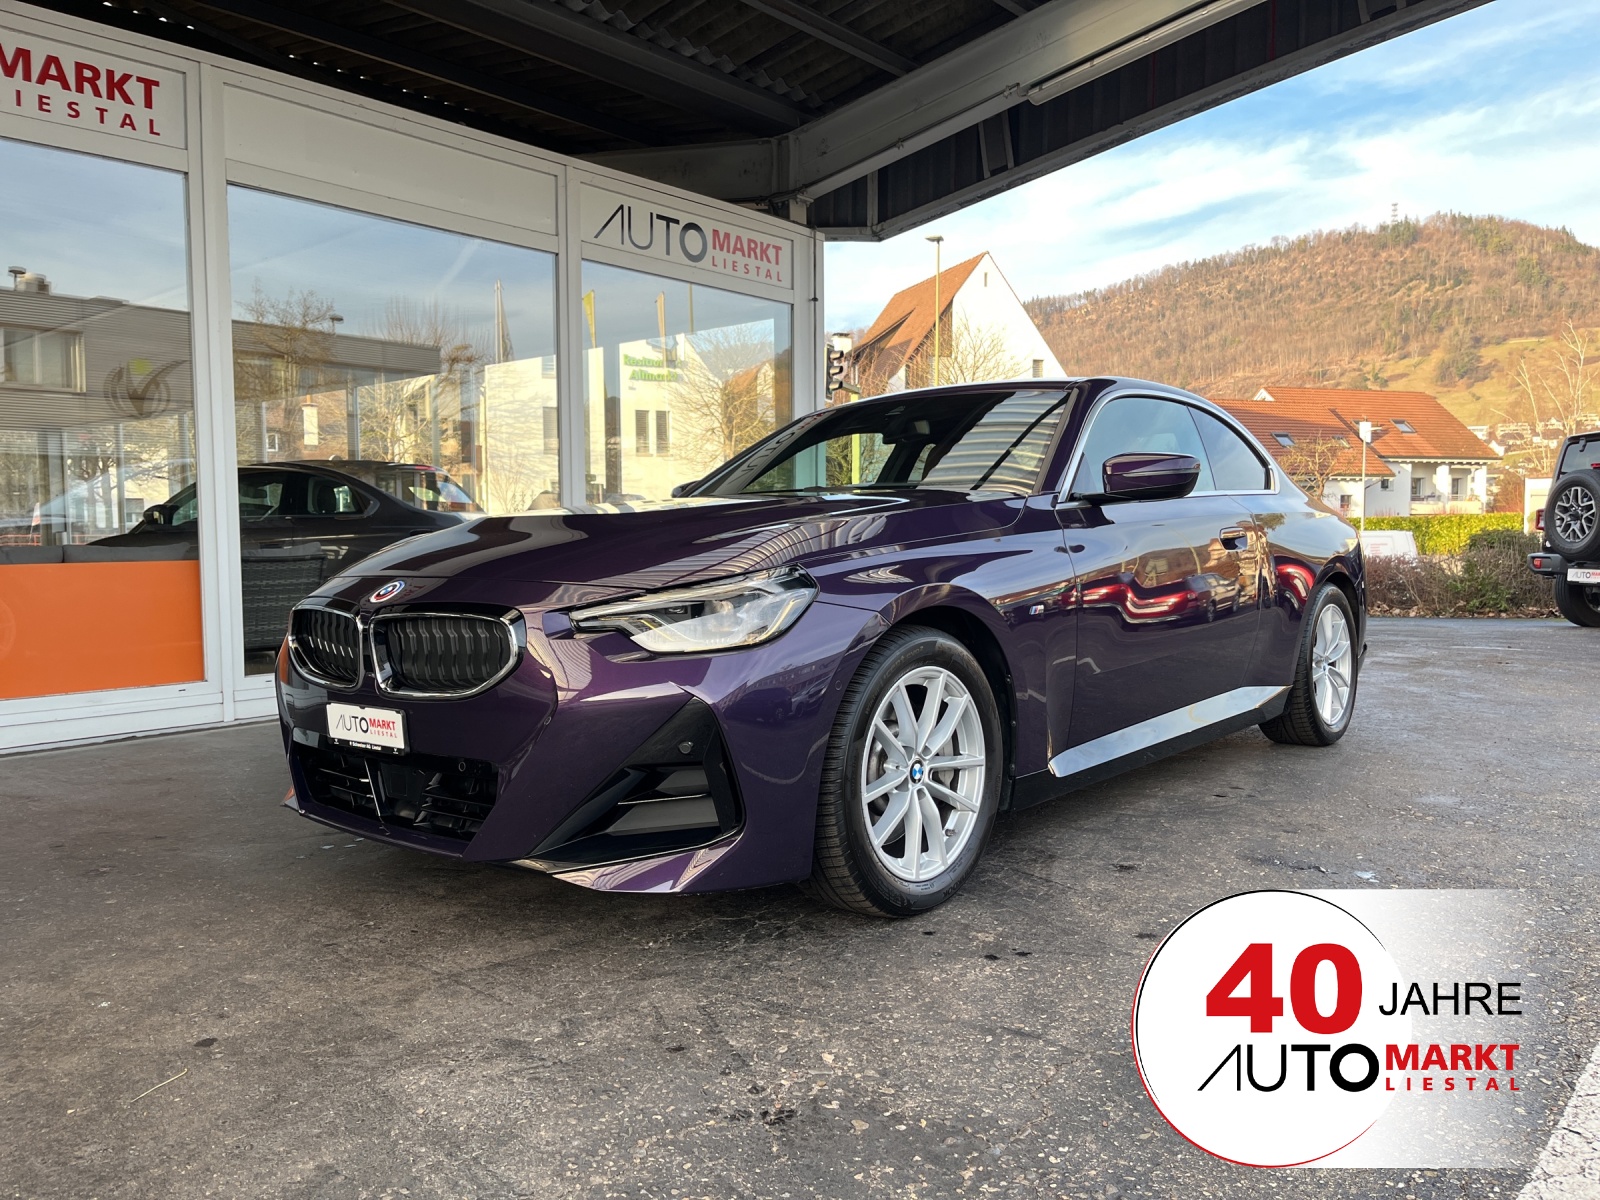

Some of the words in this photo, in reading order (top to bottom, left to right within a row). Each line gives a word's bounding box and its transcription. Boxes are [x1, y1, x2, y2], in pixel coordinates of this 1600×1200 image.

[0, 43, 160, 110] MARKT
[15, 89, 161, 136] IESTAL
[593, 203, 708, 263] AUTO
[711, 228, 782, 266] MARKT
[711, 255, 783, 282] LIESTAL
[336, 714, 369, 733] AUTO
[369, 718, 396, 731] MARKT
[370, 730, 398, 739] LIESTAL
